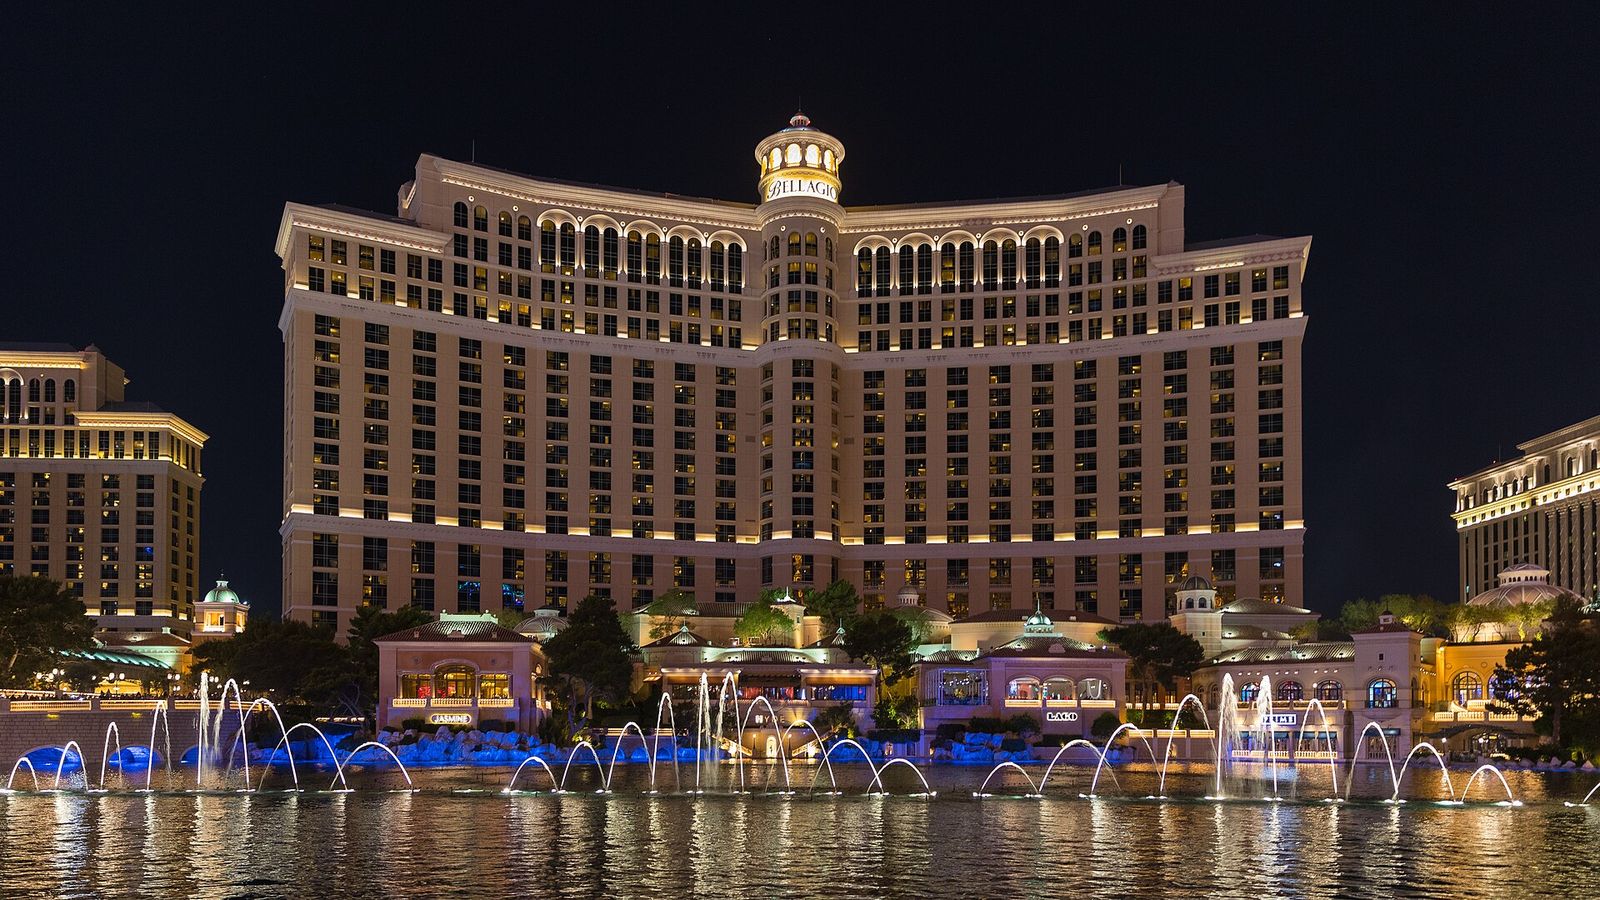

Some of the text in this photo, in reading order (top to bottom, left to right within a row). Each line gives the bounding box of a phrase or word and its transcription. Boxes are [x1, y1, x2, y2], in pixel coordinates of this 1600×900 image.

[767, 180, 837, 200] BELLAGIO
[434, 715, 467, 723] JASMINE
[1047, 712, 1078, 721] LAGO
